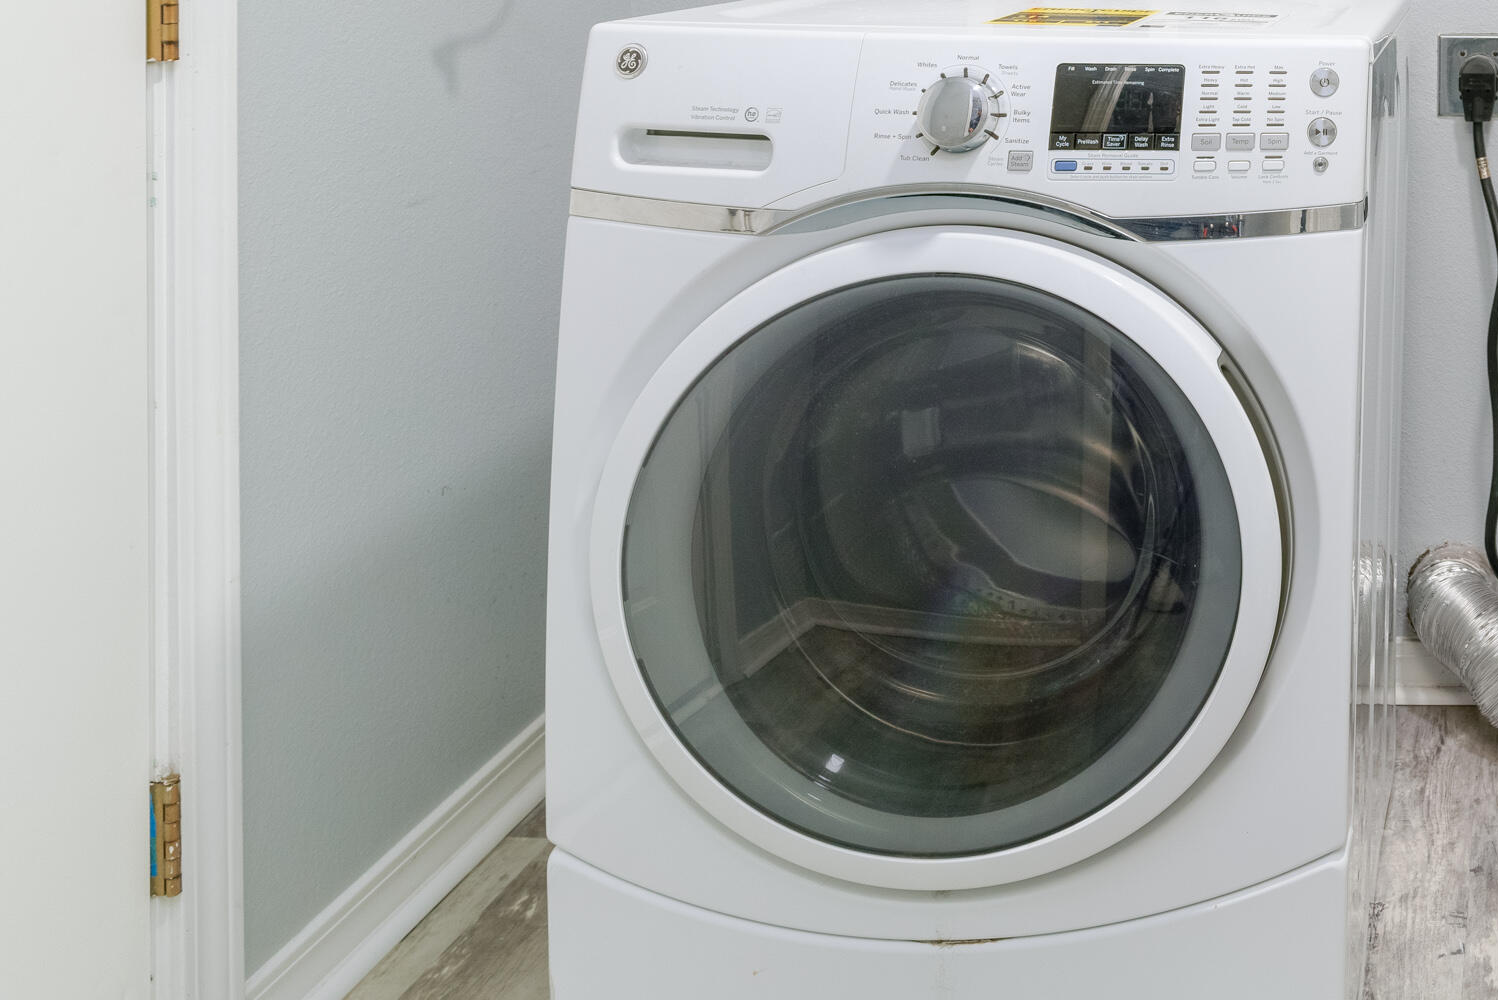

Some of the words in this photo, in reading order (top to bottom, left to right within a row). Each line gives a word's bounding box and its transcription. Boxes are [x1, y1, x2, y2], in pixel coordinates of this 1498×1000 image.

[999, 63, 1018, 71] Towels
[710, 105, 739, 113] Technology
[1013, 109, 1031, 117] Bulky
[898, 133, 912, 142] Spin
